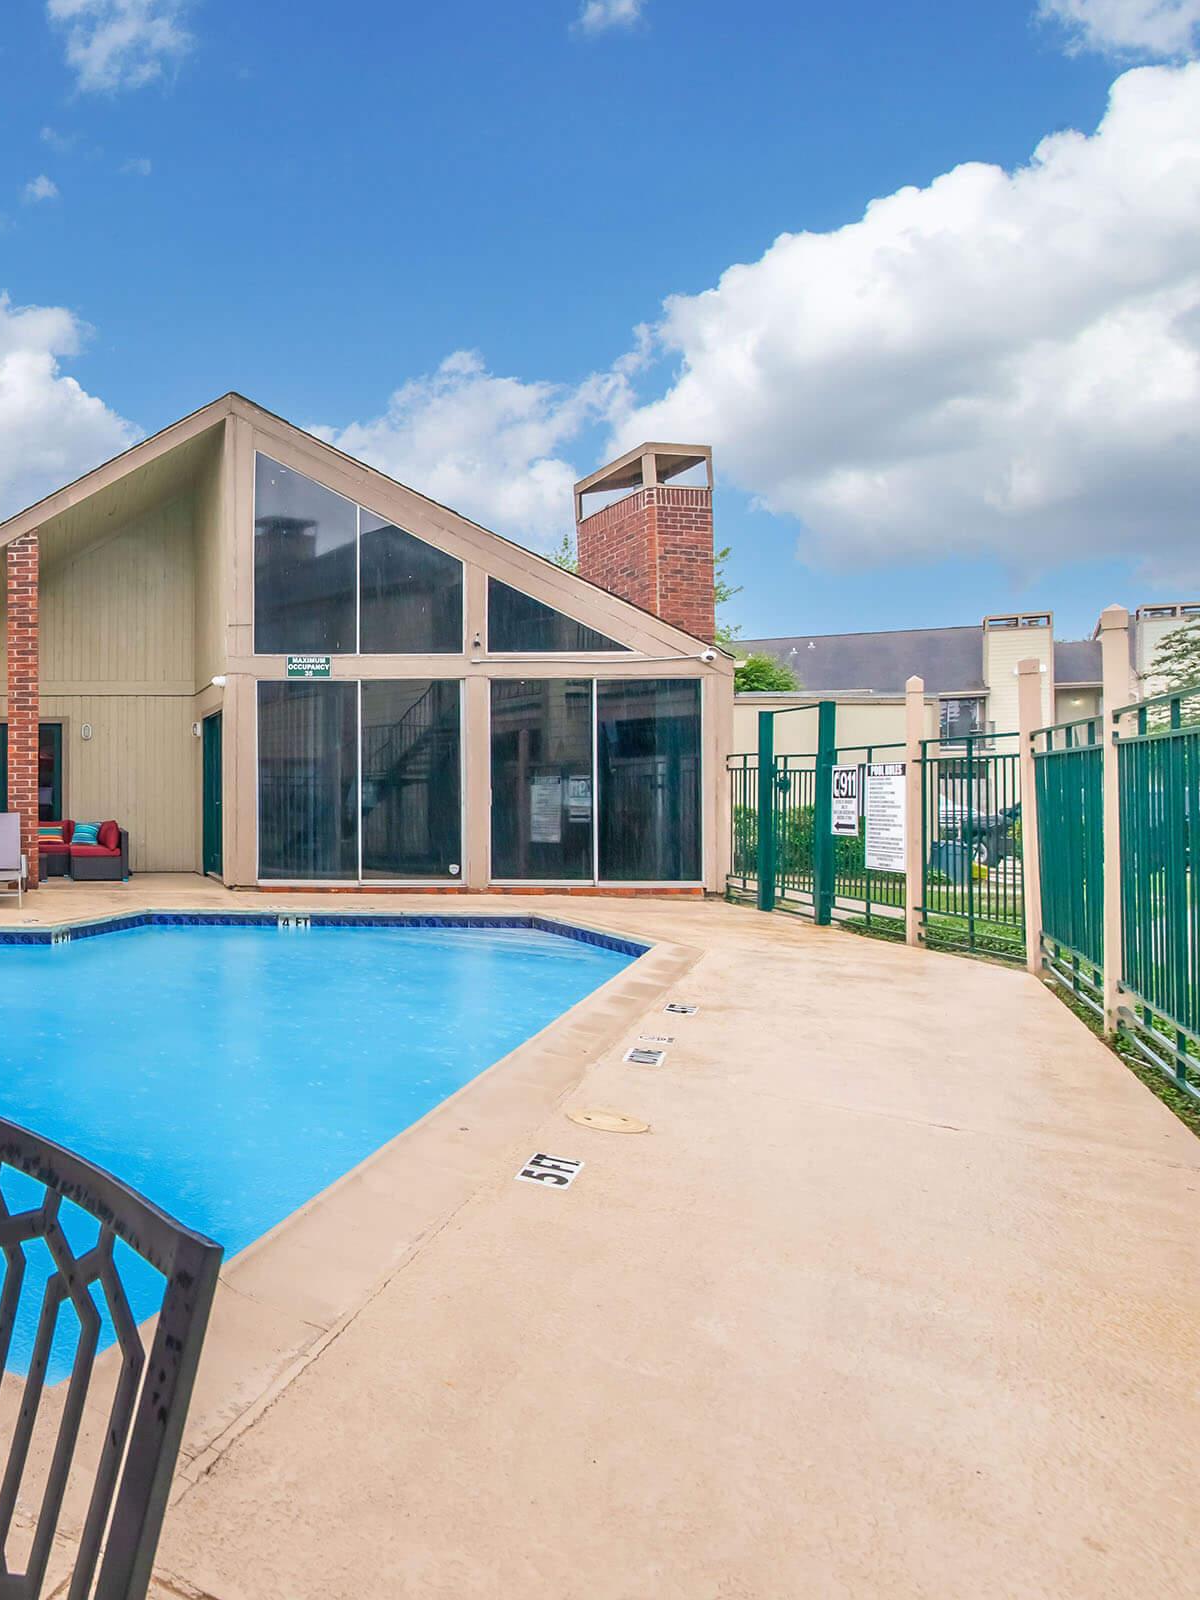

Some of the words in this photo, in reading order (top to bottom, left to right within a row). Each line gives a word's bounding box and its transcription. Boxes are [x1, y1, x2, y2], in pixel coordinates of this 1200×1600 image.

[870, 765, 884, 776] POOL
[840, 771, 856, 797] 911
[282, 917, 290, 926] 4
[295, 917, 310, 927] FT
[529, 1154, 581, 1173] FT.
[520, 1169, 569, 1185] 5
